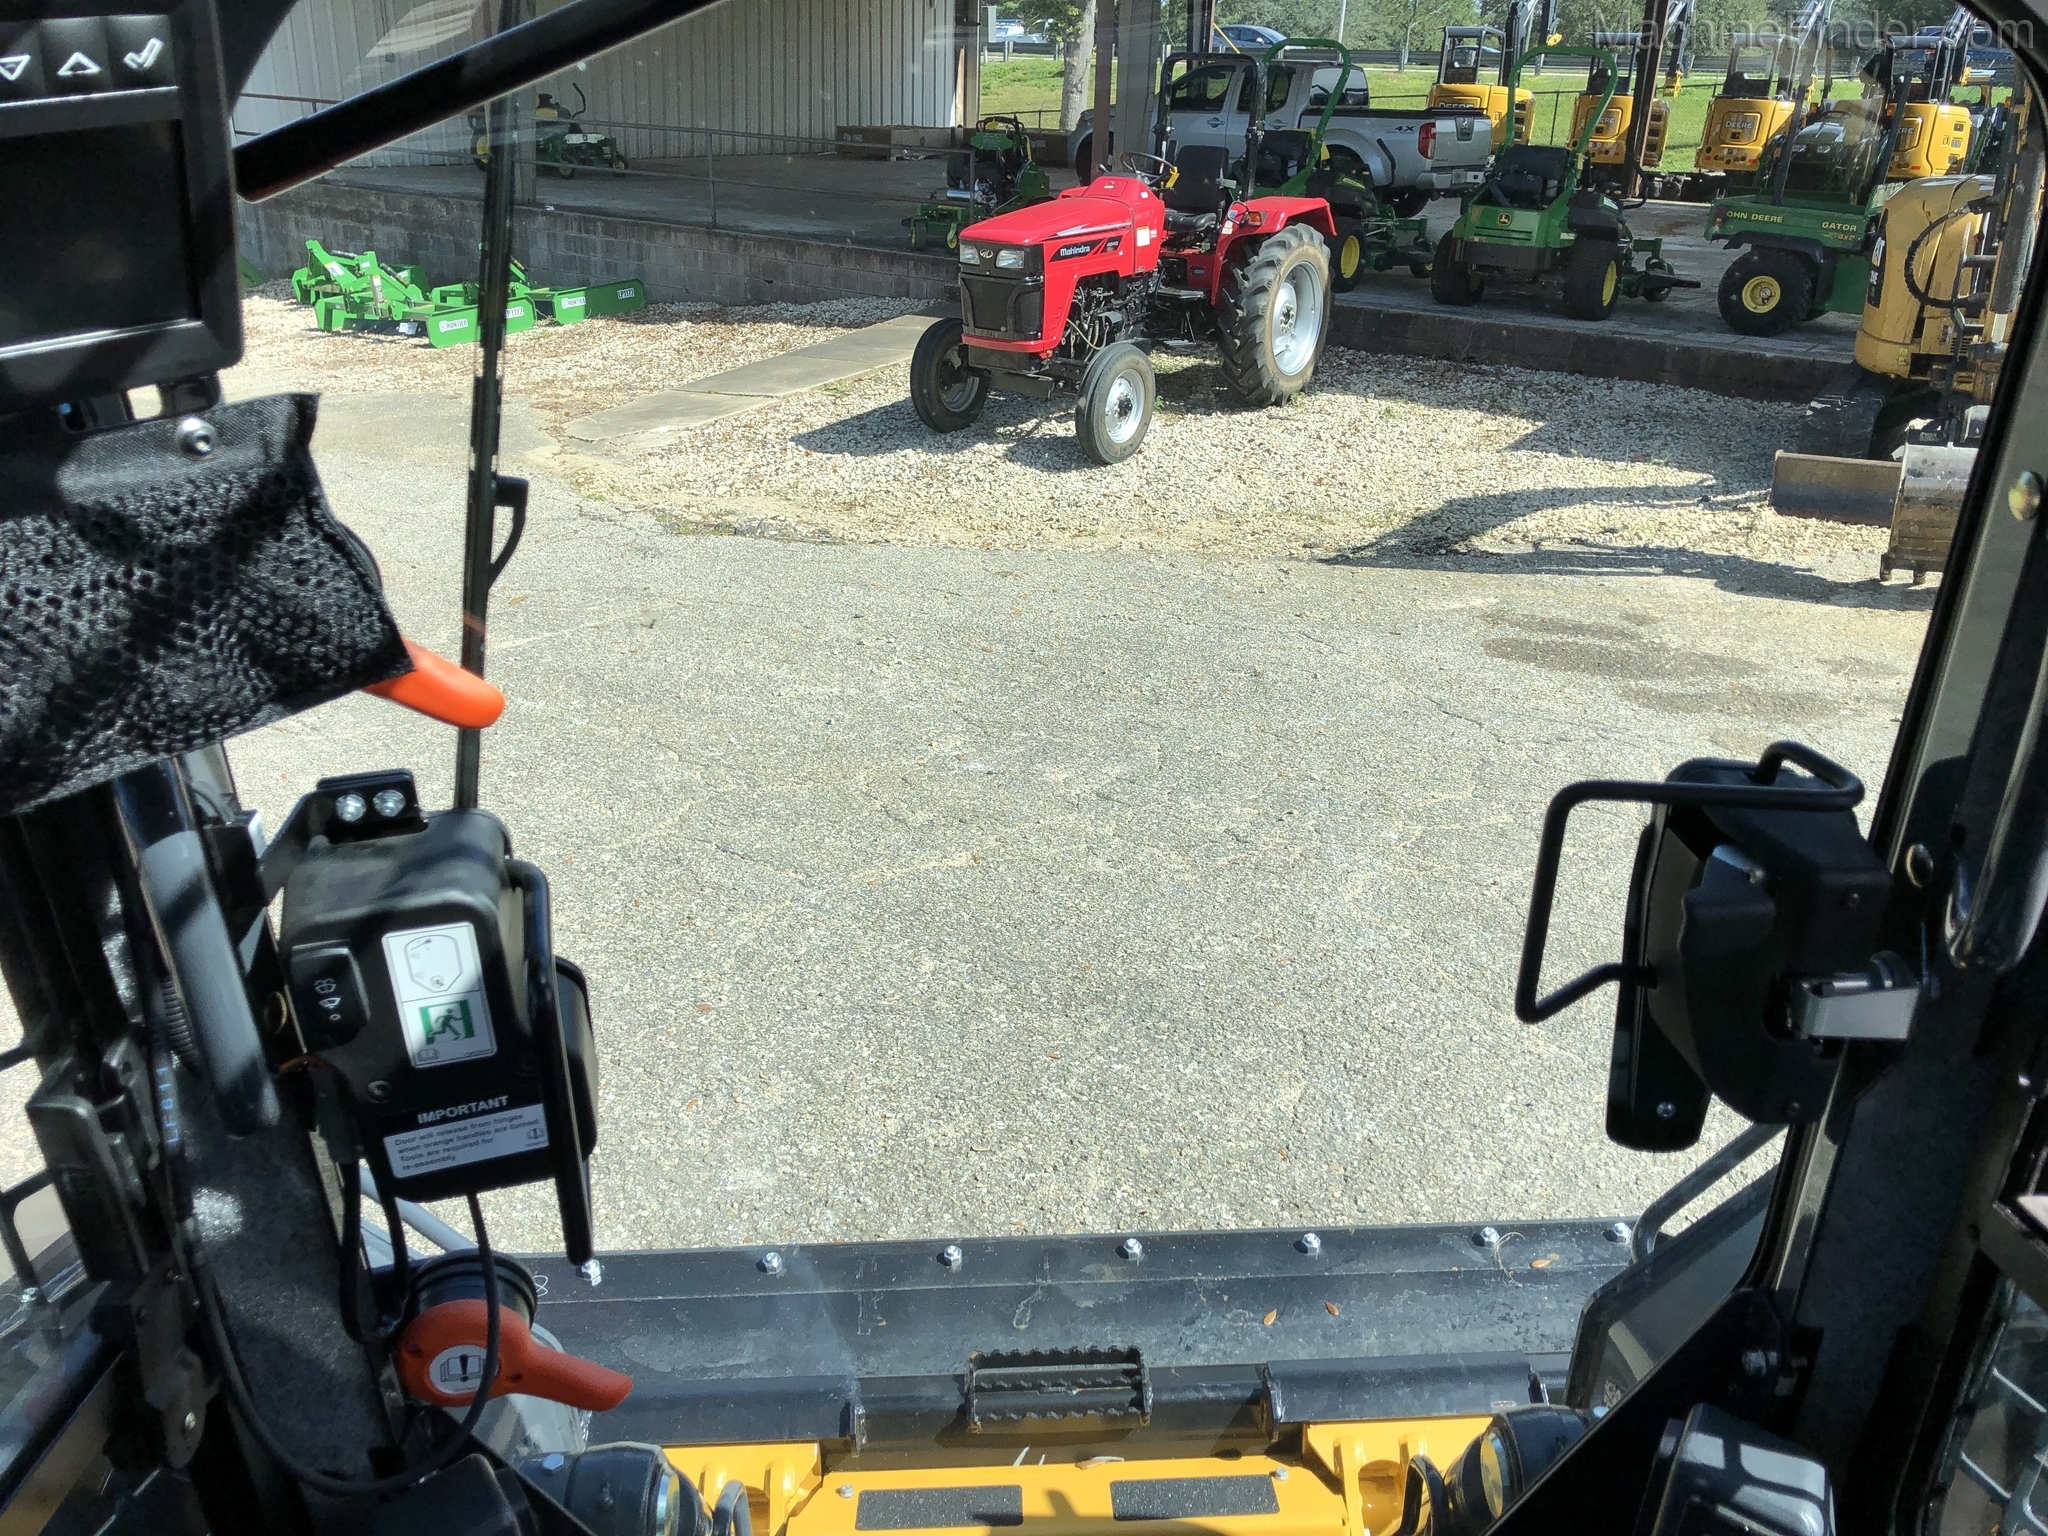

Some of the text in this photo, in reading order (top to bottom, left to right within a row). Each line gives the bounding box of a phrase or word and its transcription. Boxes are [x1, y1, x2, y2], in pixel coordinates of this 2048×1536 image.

[1725, 120, 1753, 129] DEERE
[1751, 213, 1784, 223] DEERE
[1821, 221, 1857, 232] GATOR
[1060, 245, 1091, 257] Mahindra
[416, 1095, 509, 1124] IMPORTANT
[394, 1136, 417, 1146] Door
